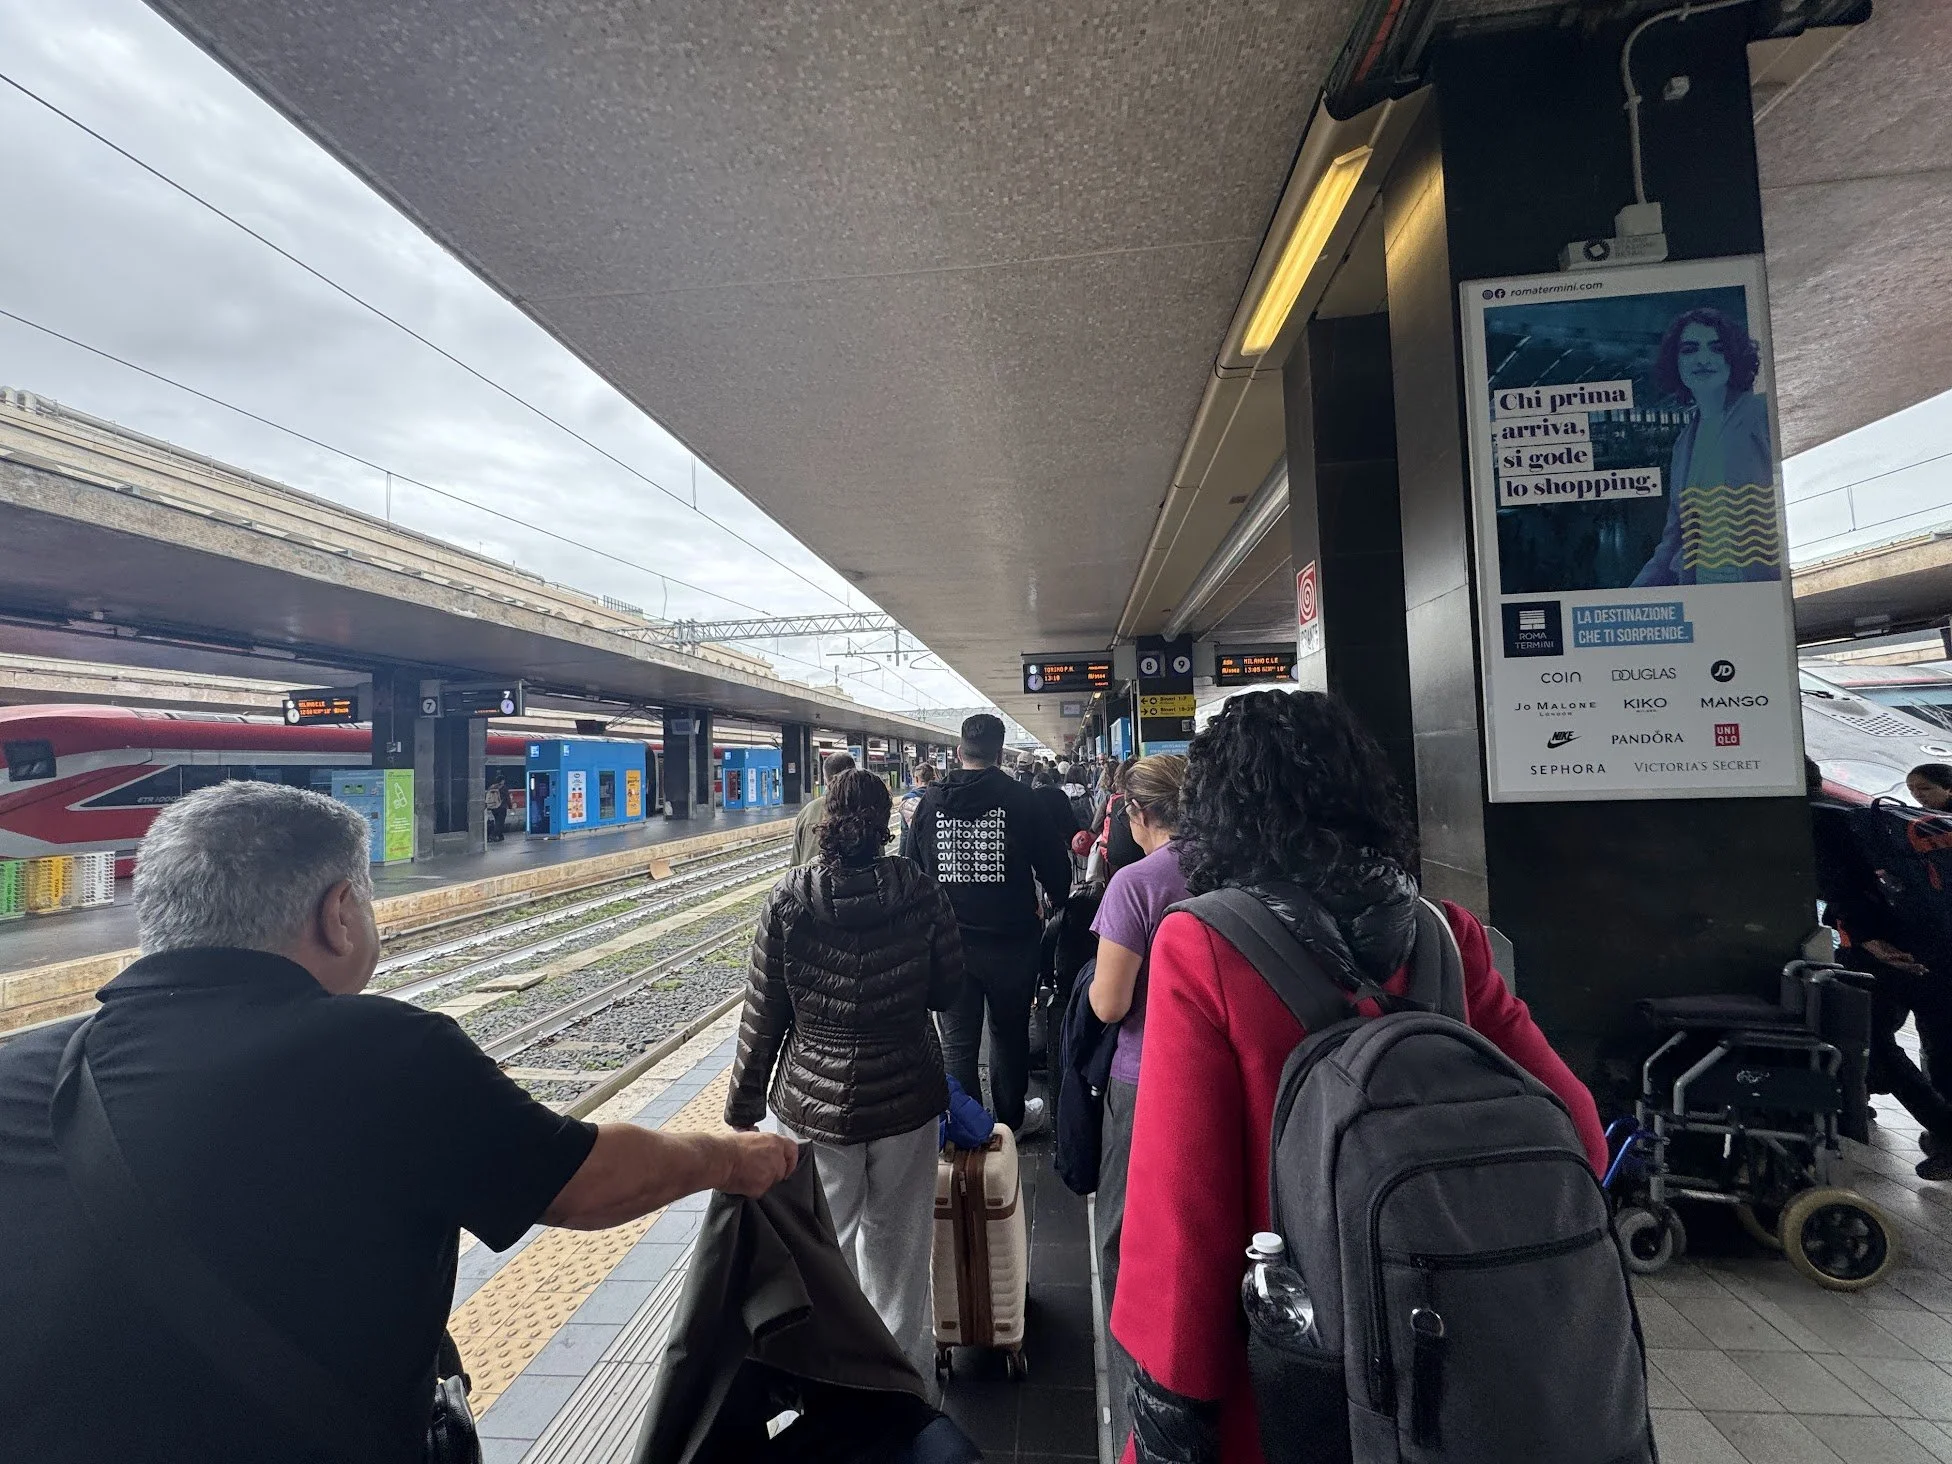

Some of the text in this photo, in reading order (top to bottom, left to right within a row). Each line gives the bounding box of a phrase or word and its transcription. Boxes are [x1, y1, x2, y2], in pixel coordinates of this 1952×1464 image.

[1510, 282, 1603, 297] romatermini.com
[1500, 387, 1626, 414] Chi prima
[1502, 419, 1586, 440] arriva,
[1503, 448, 1588, 473] si gode
[1506, 474, 1657, 500] lo shopping.
[1577, 606, 1676, 625] LA DESTINAZIONE
[1519, 632, 1547, 641] ROMA
[1578, 626, 1689, 644] CHE TI SORPRENDE.
[1515, 641, 1554, 650] TERMINI
[1611, 668, 1677, 681] DOUGLAS
[1714, 665, 1733, 677] JD
[504, 690, 510, 698] 7
[1624, 697, 1667, 709] KIKO
[1701, 695, 1769, 708] MANGO
[1552, 731, 1574, 741] NIKE
[1717, 726, 1736, 735] UNI
[1611, 731, 1684, 745] PANDORA
[1717, 735, 1737, 745] QLO
[1530, 763, 1606, 776] SEPHORA
[1634, 760, 1761, 773] VICTORIA'S SECRET
[936, 818, 1005, 828] avito.tech
[936, 828, 1005, 839] avito.tech
[937, 840, 1005, 850] avito.tech
[938, 850, 1005, 861] avito.tech
[938, 861, 1005, 872] avito.tech
[938, 872, 1005, 882] avito.tech
